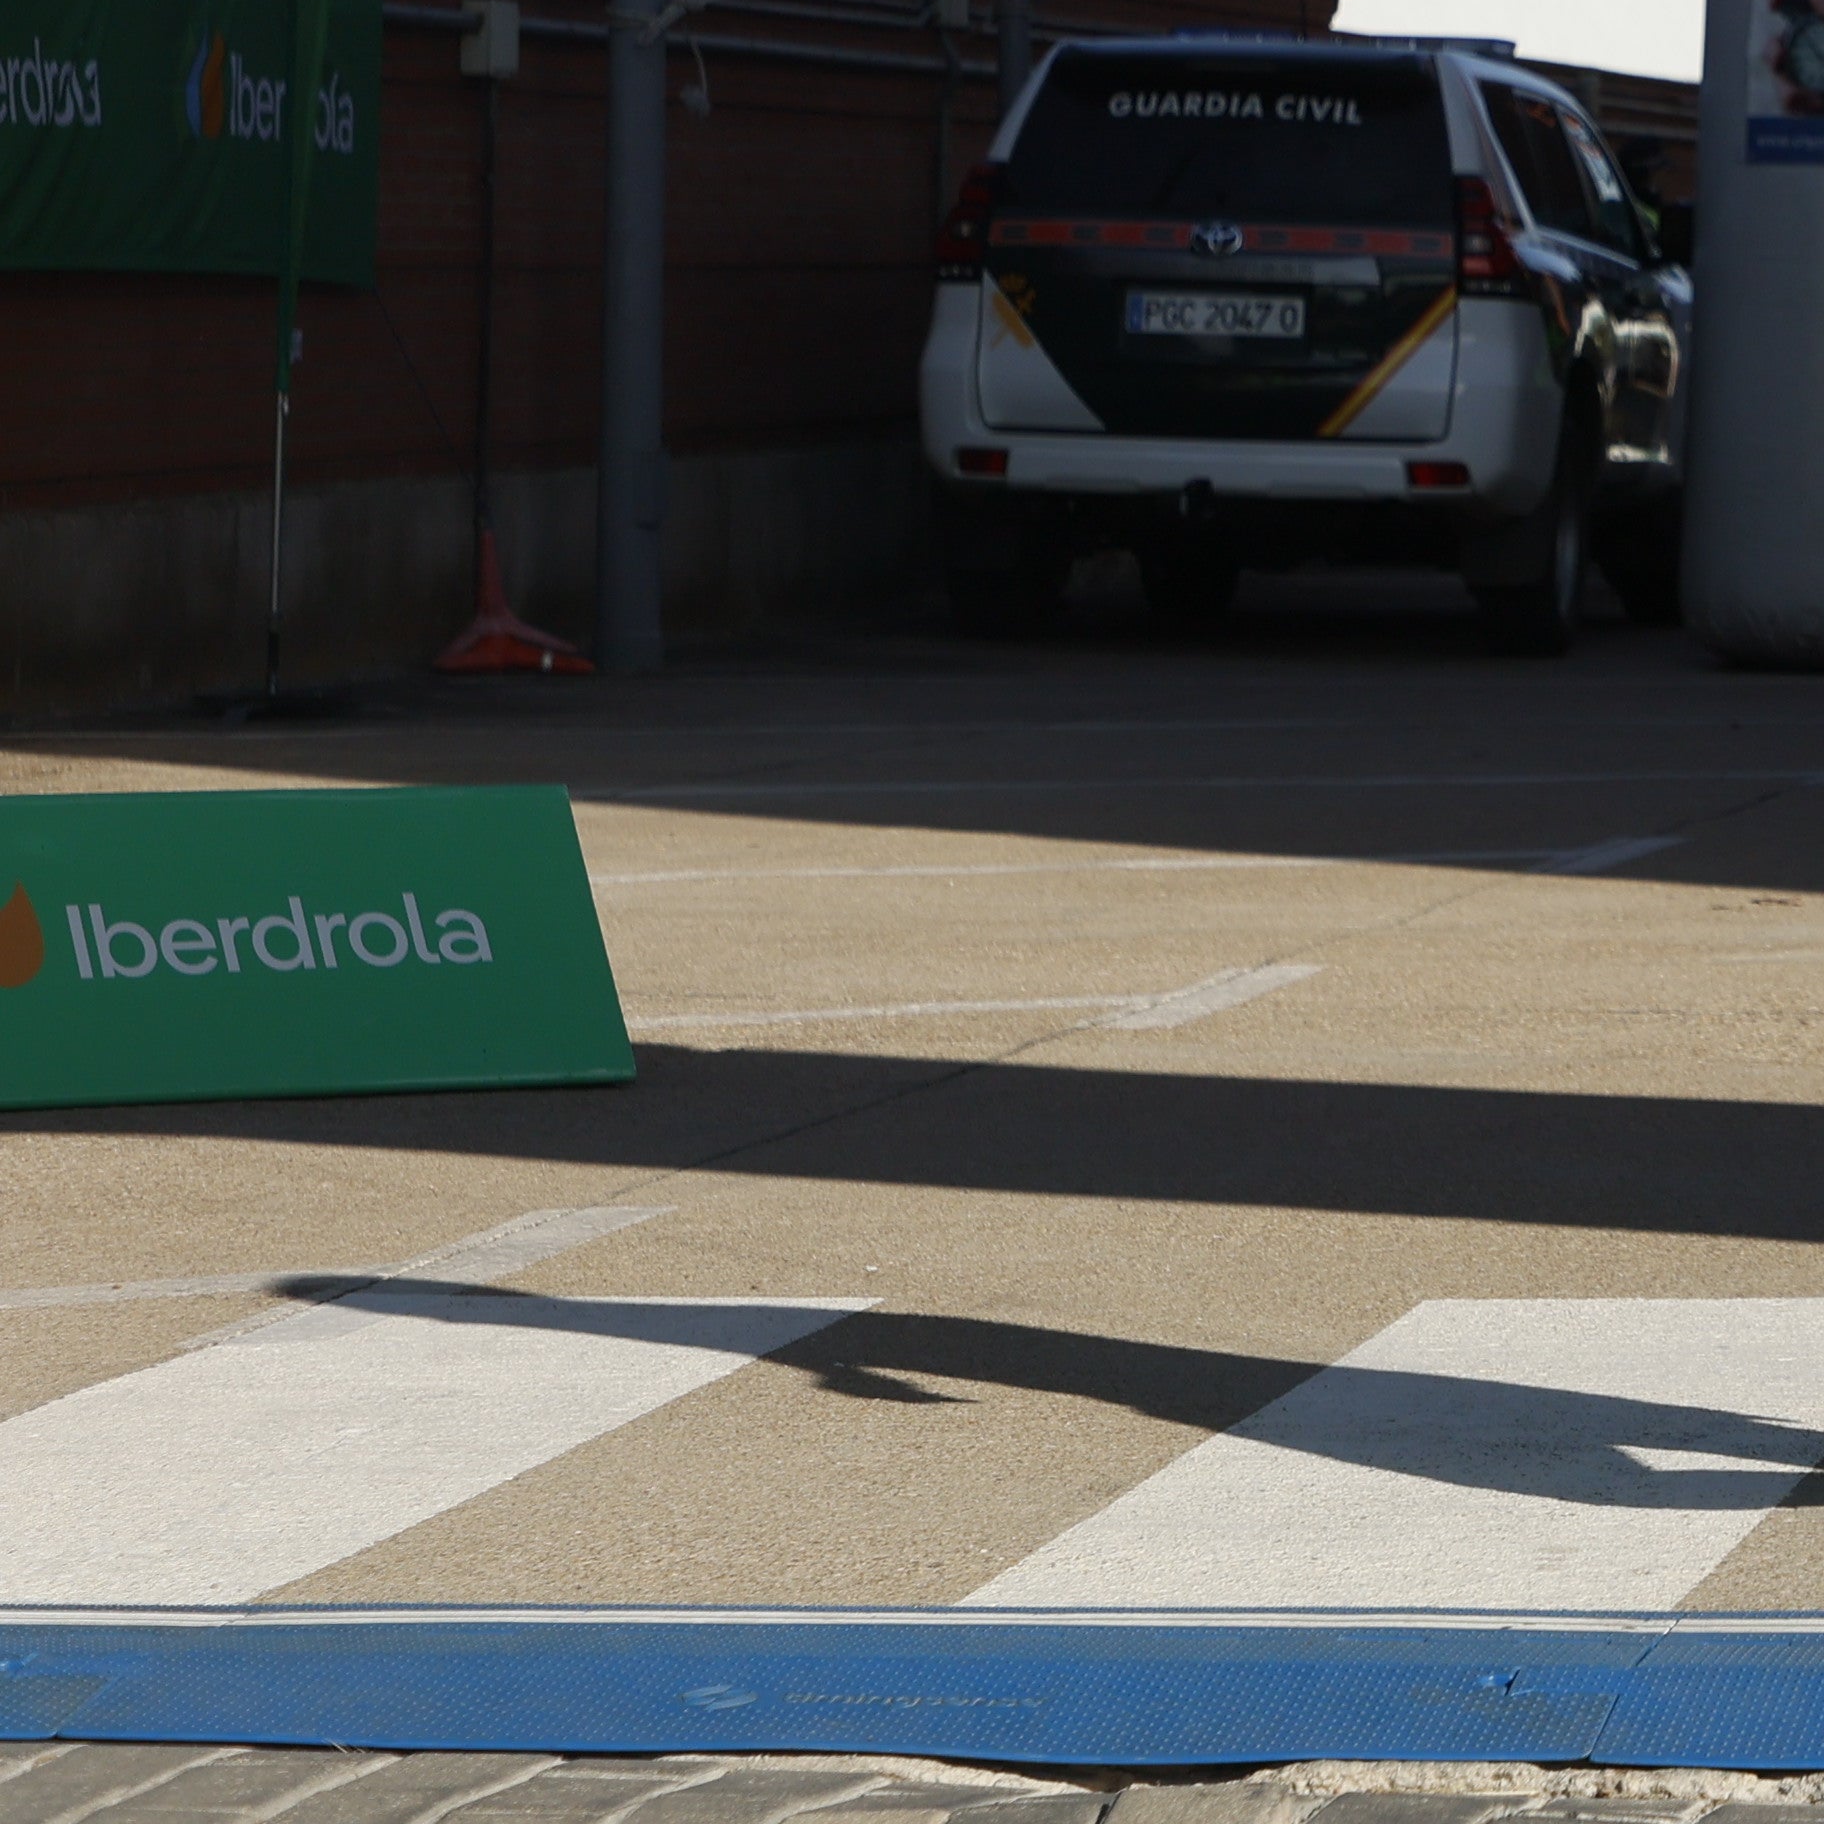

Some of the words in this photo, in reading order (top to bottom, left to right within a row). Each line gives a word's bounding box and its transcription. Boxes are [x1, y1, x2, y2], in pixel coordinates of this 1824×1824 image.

[1108, 91, 1265, 119] GUARDIA
[1275, 94, 1362, 126] CIVIL
[65, 892, 493, 980] Iberdrola
